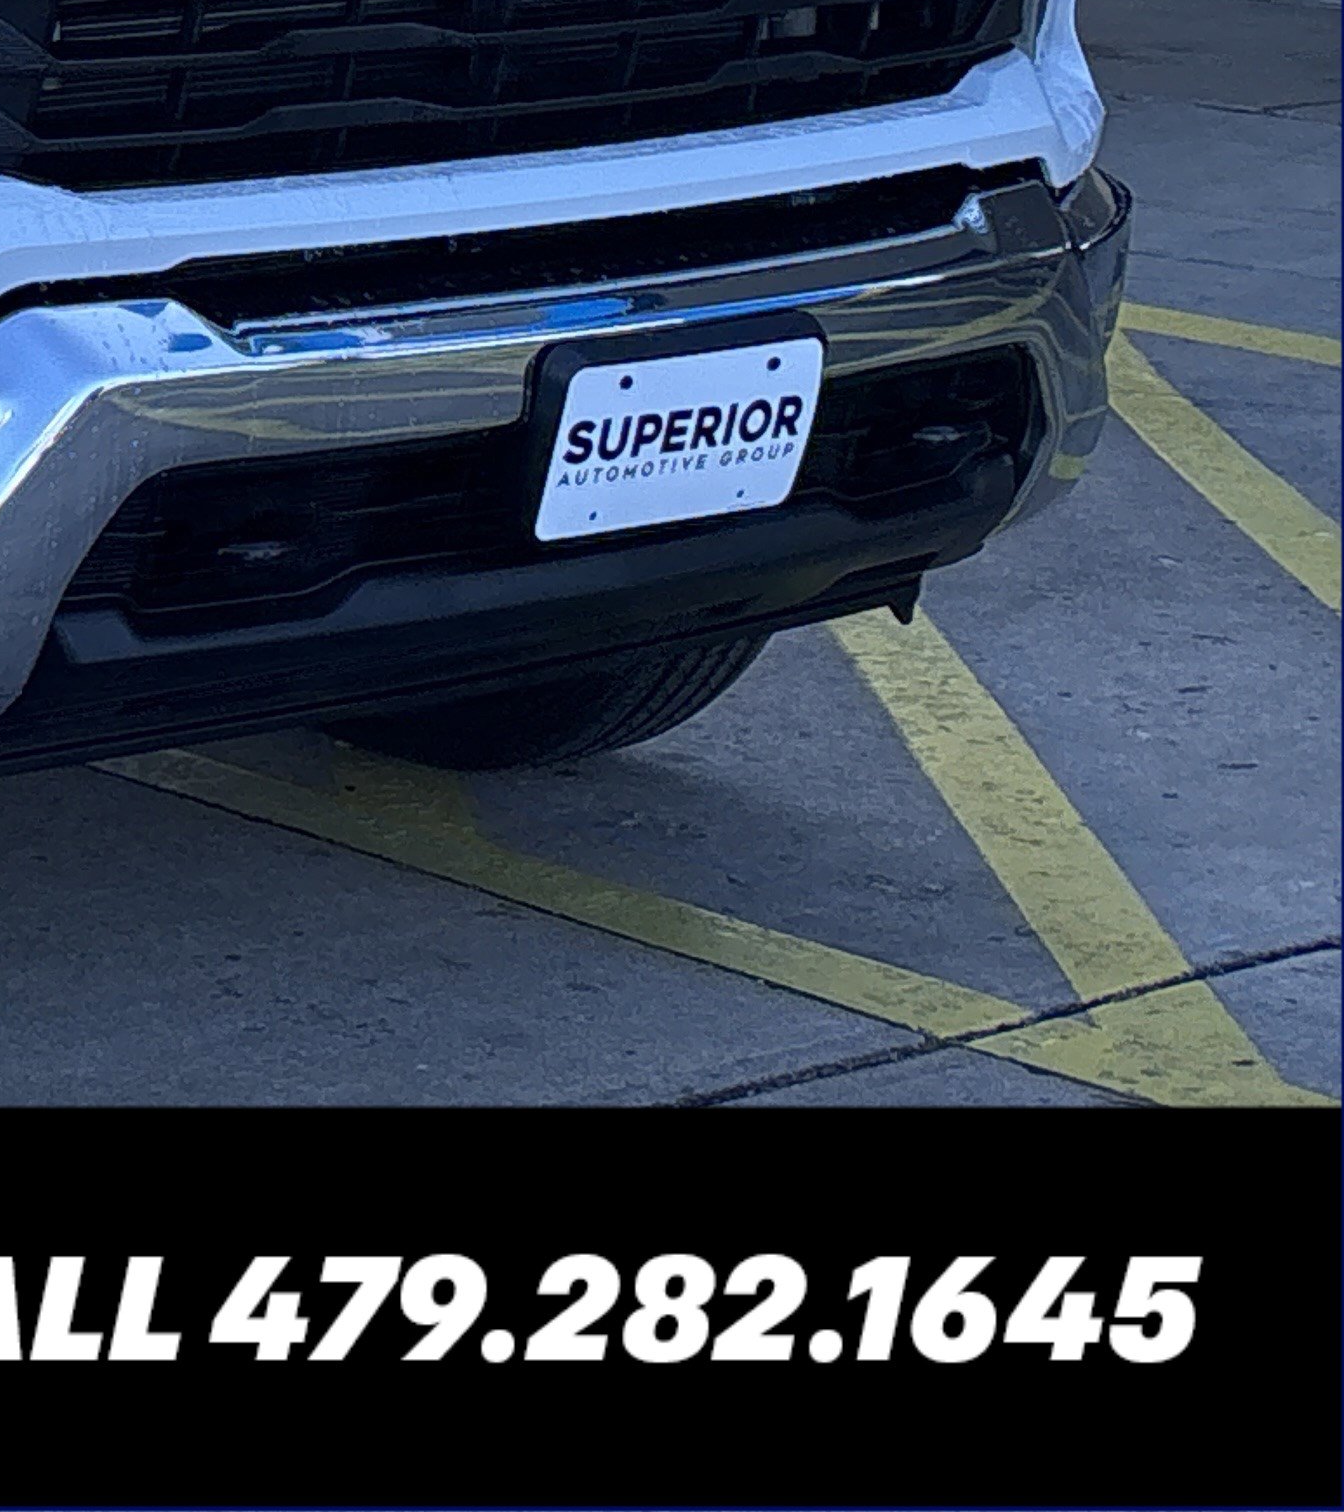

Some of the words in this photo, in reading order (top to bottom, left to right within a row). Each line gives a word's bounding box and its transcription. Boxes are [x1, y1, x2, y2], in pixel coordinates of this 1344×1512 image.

[562, 394, 803, 466] SUPERIOR
[555, 453, 709, 488] AUTOMOTIVE
[718, 441, 796, 468] GROUP
